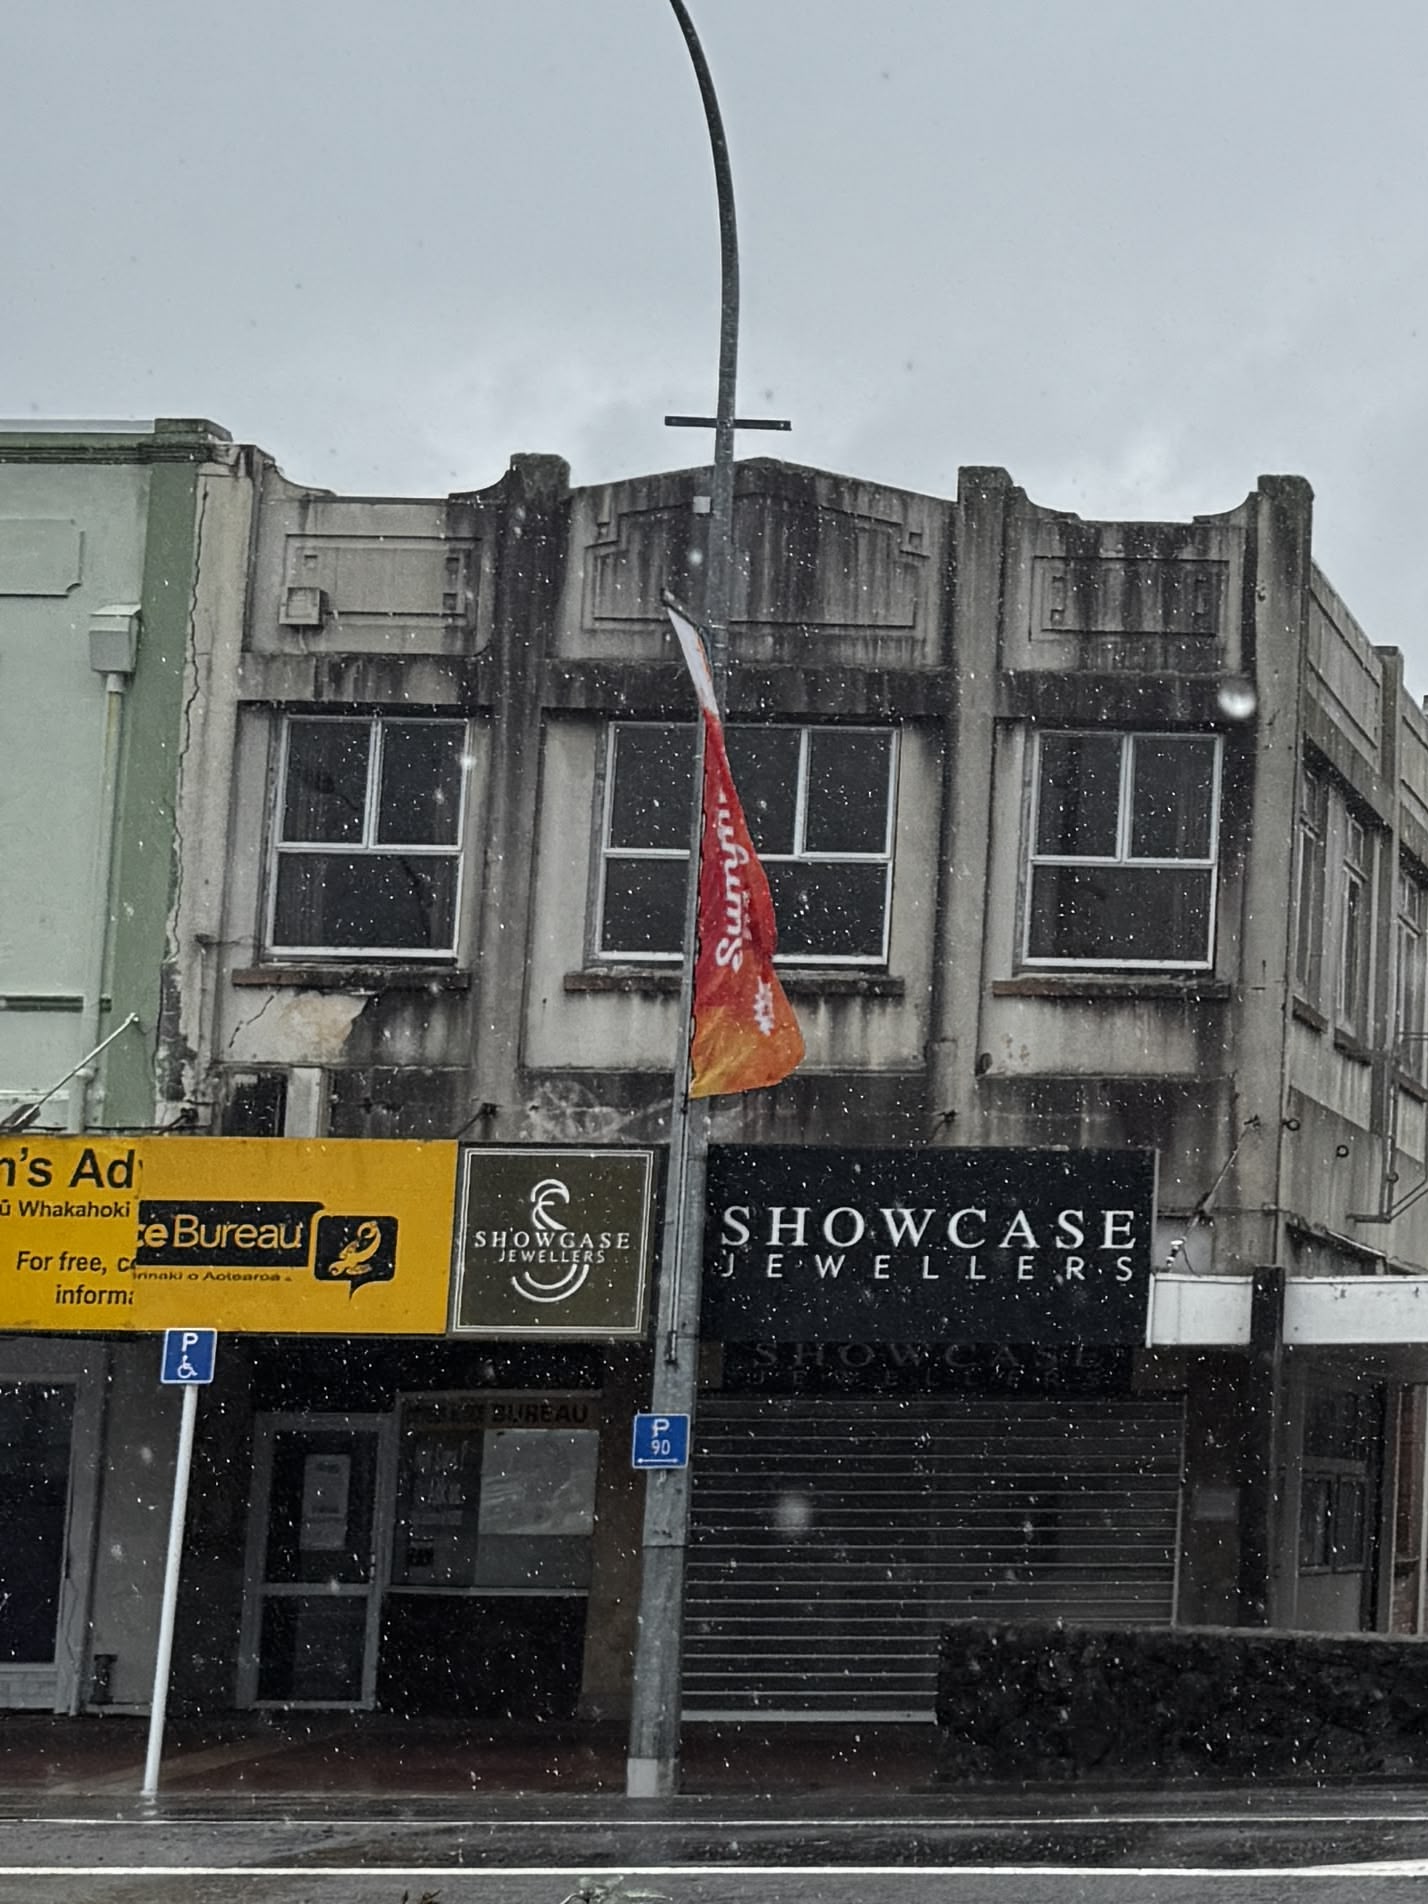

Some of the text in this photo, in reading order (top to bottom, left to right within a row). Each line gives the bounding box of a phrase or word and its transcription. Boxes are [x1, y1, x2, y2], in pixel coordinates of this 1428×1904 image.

[68, 1147, 144, 1189] Ad
[18, 1200, 131, 1218] Whakahoki
[173, 1214, 302, 1249] Bureau
[720, 1205, 1137, 1249] SHOWCASE
[16, 1251, 53, 1271] For
[58, 1252, 108, 1274] free,
[499, 1249, 606, 1263] JEWELLERS
[202, 1271, 281, 1281] Aotearoa
[719, 1254, 1134, 1281] JEWELLERS
[181, 1332, 199, 1353] P
[491, 1402, 589, 1424] BUREAU
[651, 1418, 671, 1439] P
[651, 1439, 671, 1456] 90
